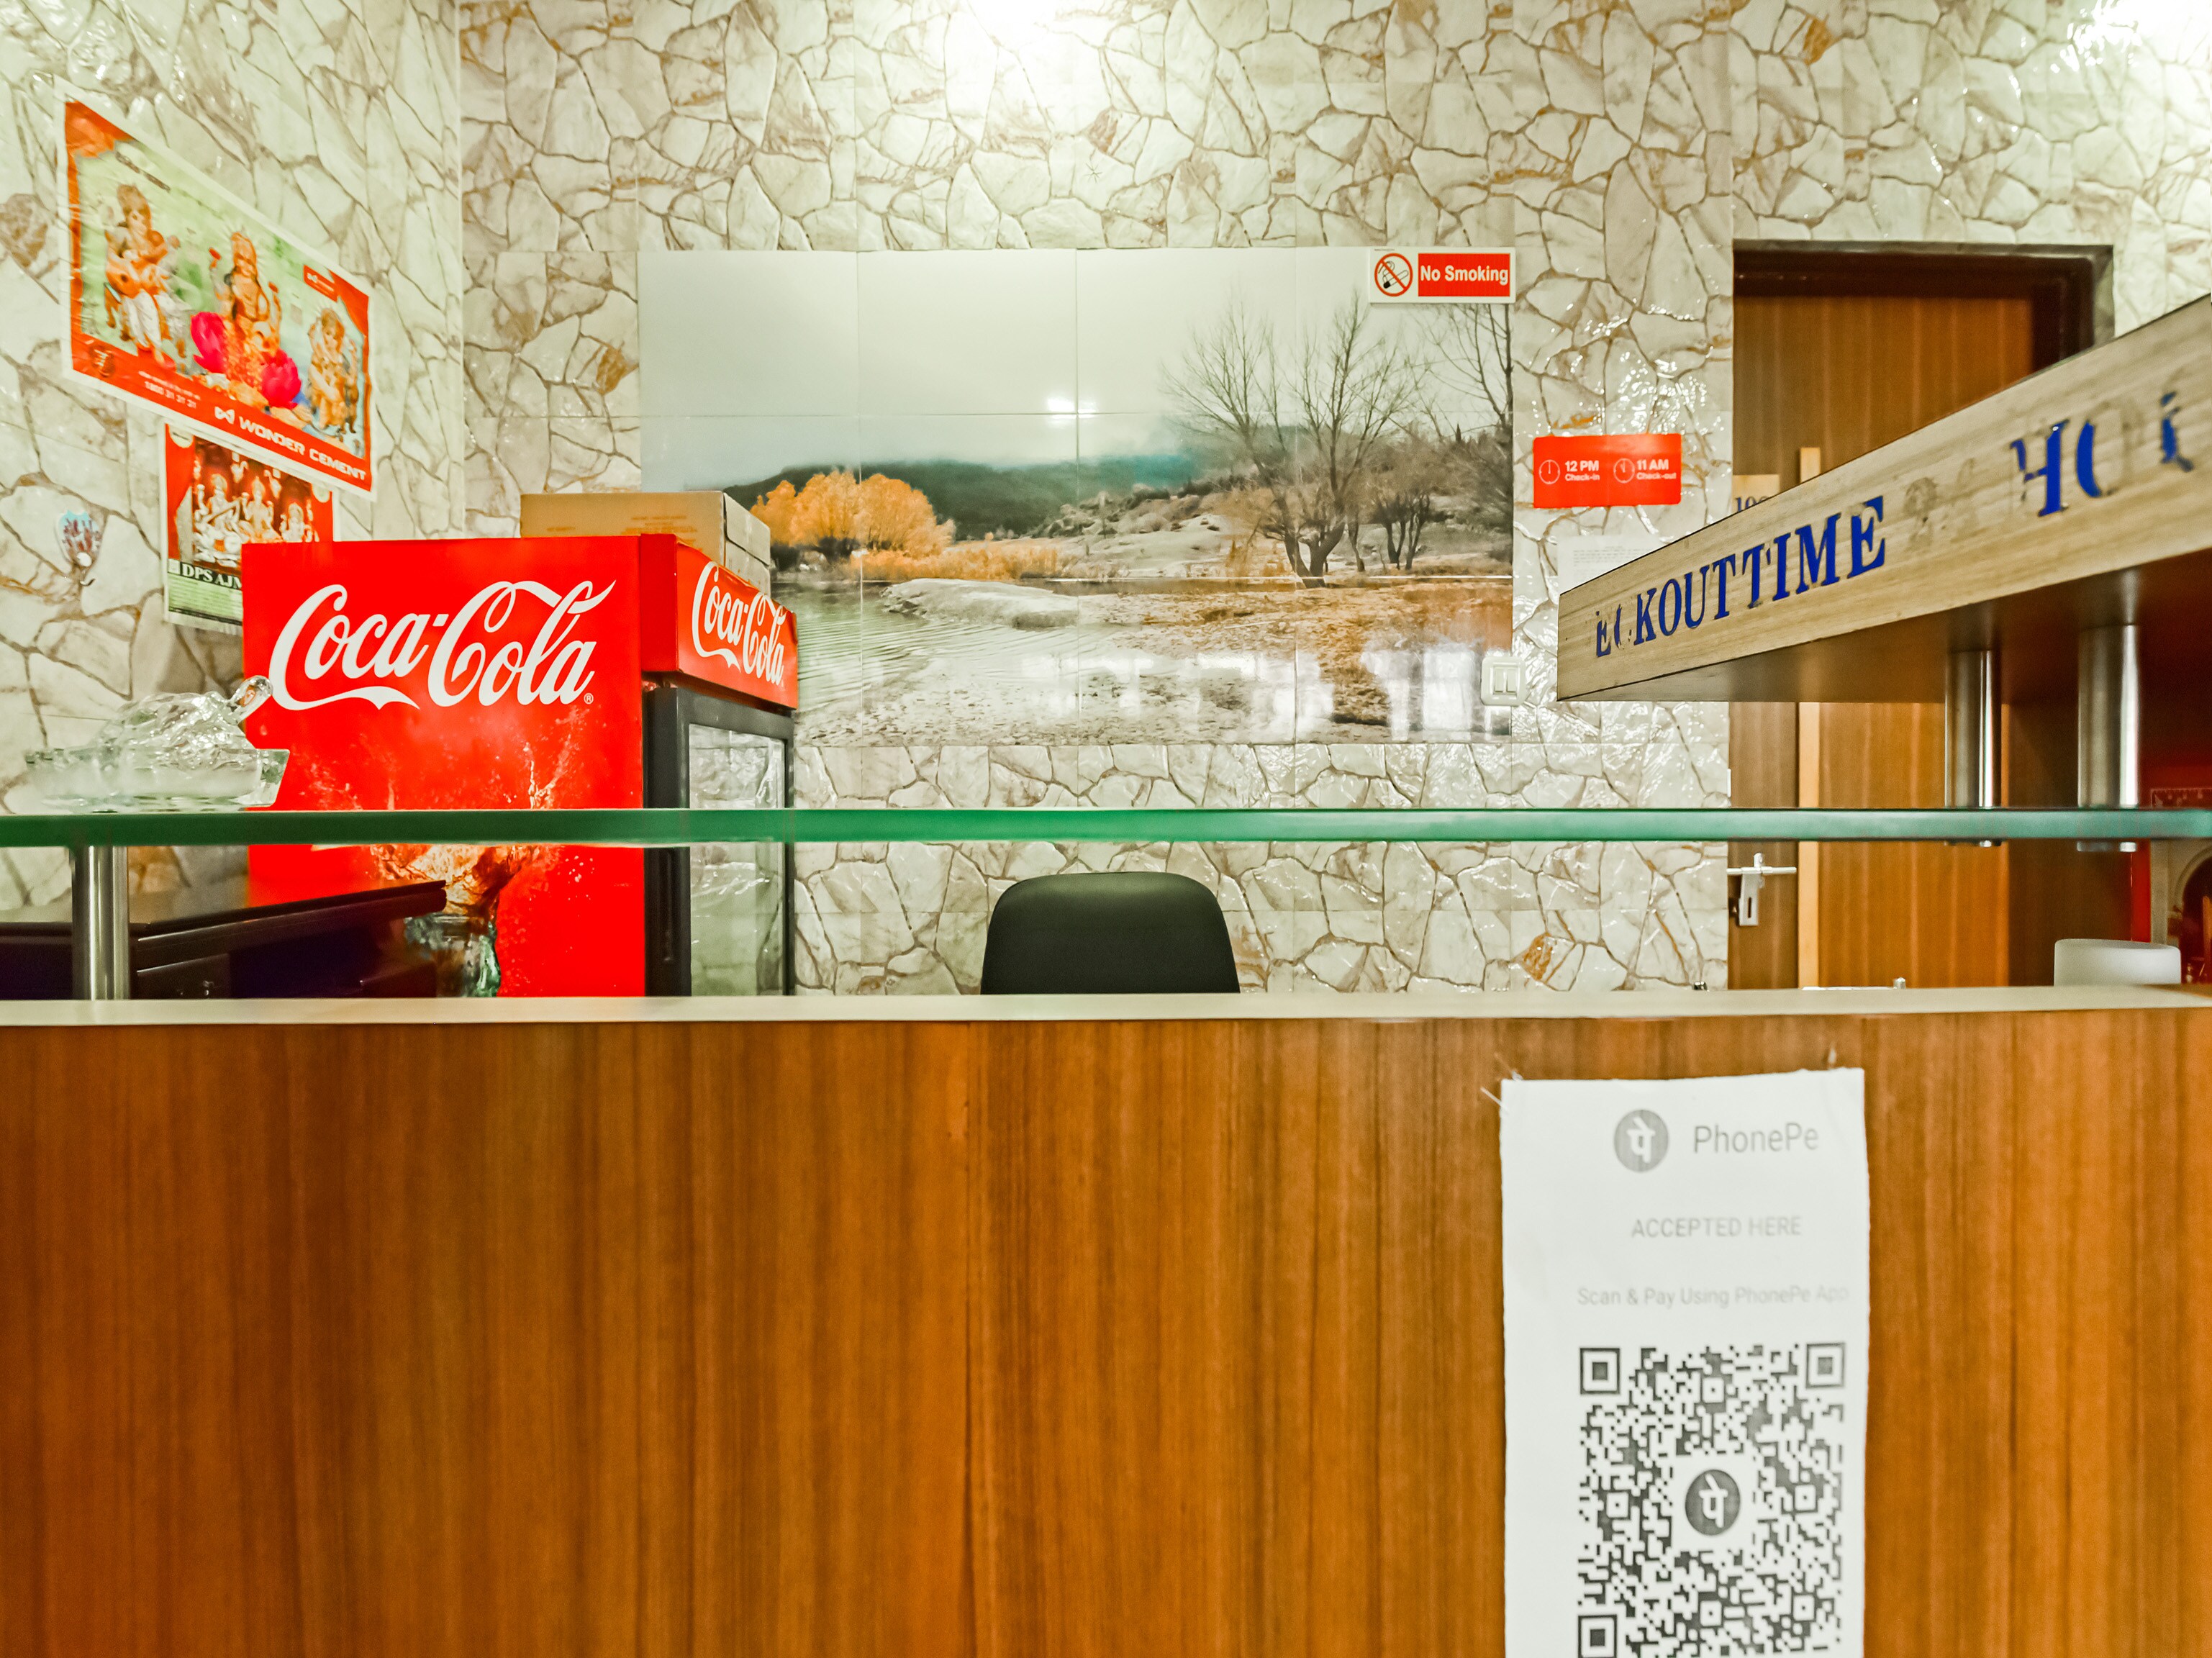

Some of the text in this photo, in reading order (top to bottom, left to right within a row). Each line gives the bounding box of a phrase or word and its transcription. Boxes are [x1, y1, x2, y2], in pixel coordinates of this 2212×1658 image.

[1420, 265, 1508, 286] No Smoking
[239, 416, 366, 480] WONDER CEMENT
[1565, 461, 1599, 472] 12 PM
[1637, 459, 1669, 471] 11 AM
[182, 563, 213, 582] DPS
[692, 561, 789, 687] Coca-Cola
[268, 579, 616, 710] Coca-Cola
[1693, 1122, 1819, 1154] PhonePe
[1631, 1216, 1802, 1238] ACCEPTED HERE
[1578, 1284, 1850, 1310] Scan & Pay Using PhonePe App
